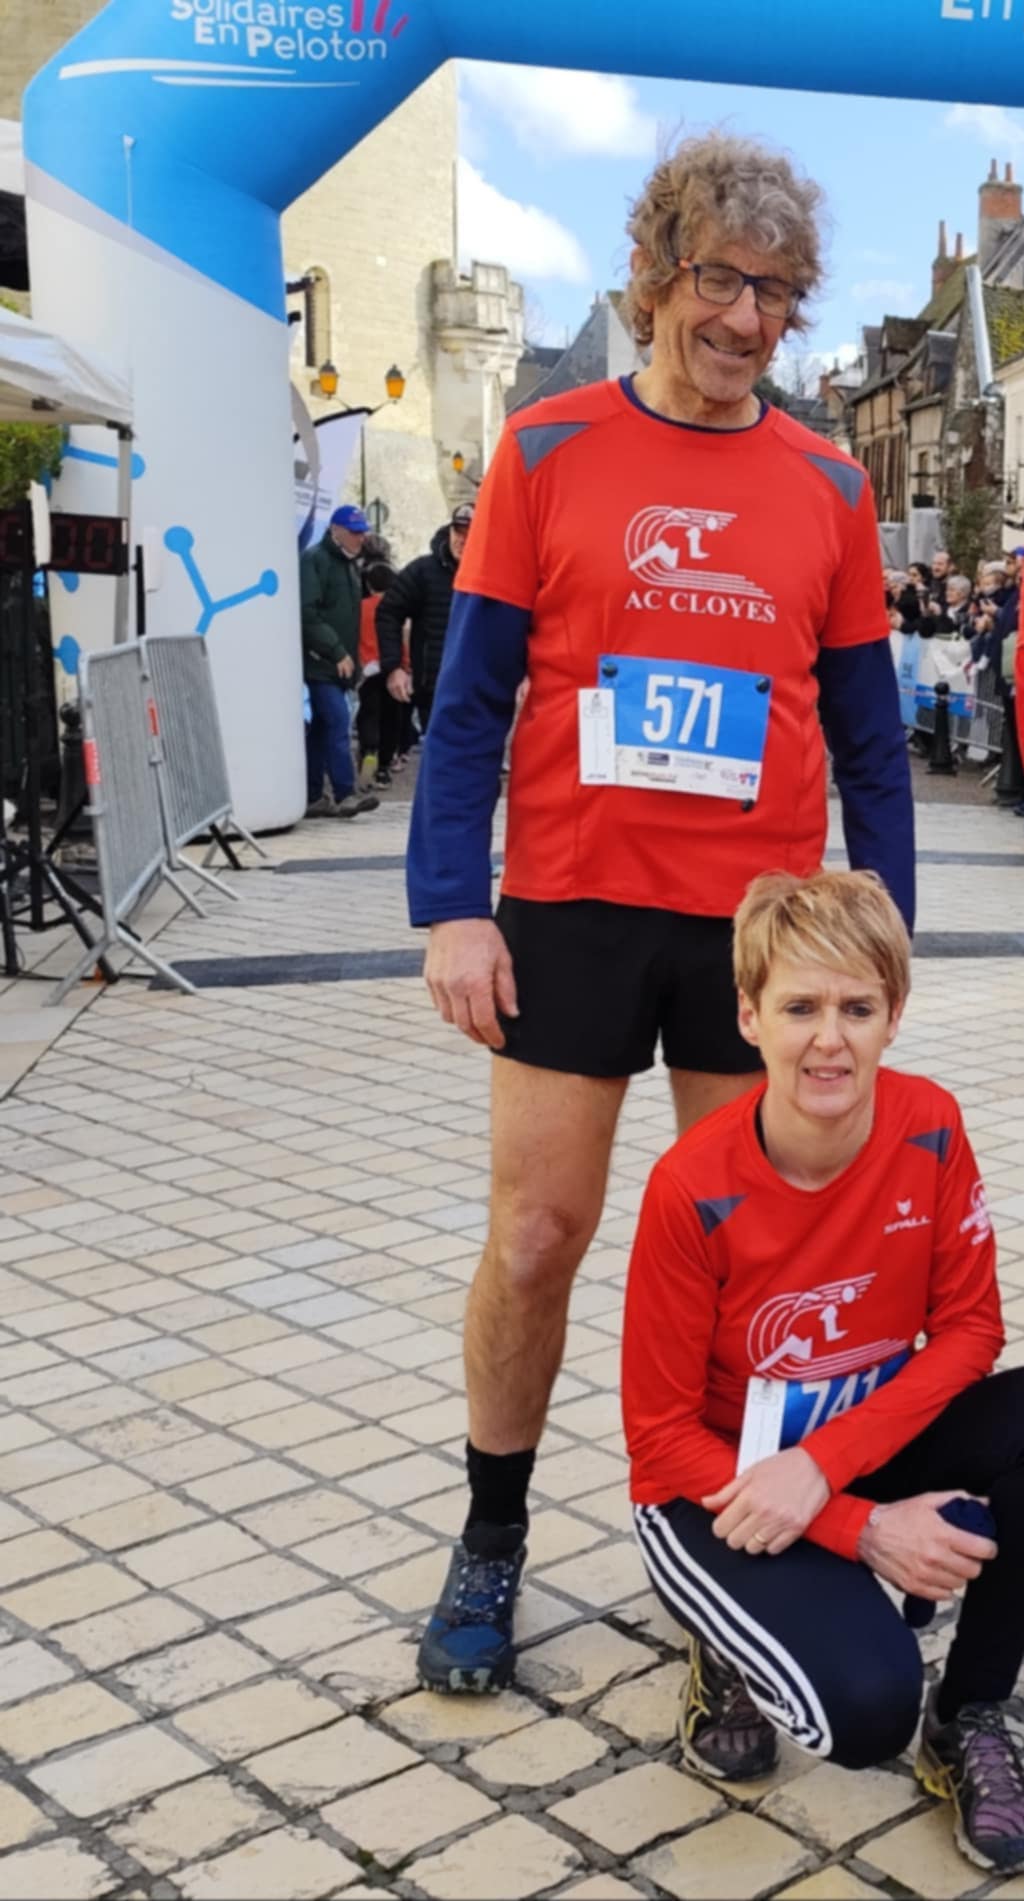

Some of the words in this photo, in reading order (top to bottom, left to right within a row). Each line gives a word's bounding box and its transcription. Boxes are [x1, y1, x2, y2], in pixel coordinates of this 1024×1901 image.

[194, 16, 239, 45] En
[247, 26, 388, 61] Peloton
[624, 589, 663, 610] AC
[669, 591, 777, 624] CLOYES
[642, 673, 723, 749] 571
